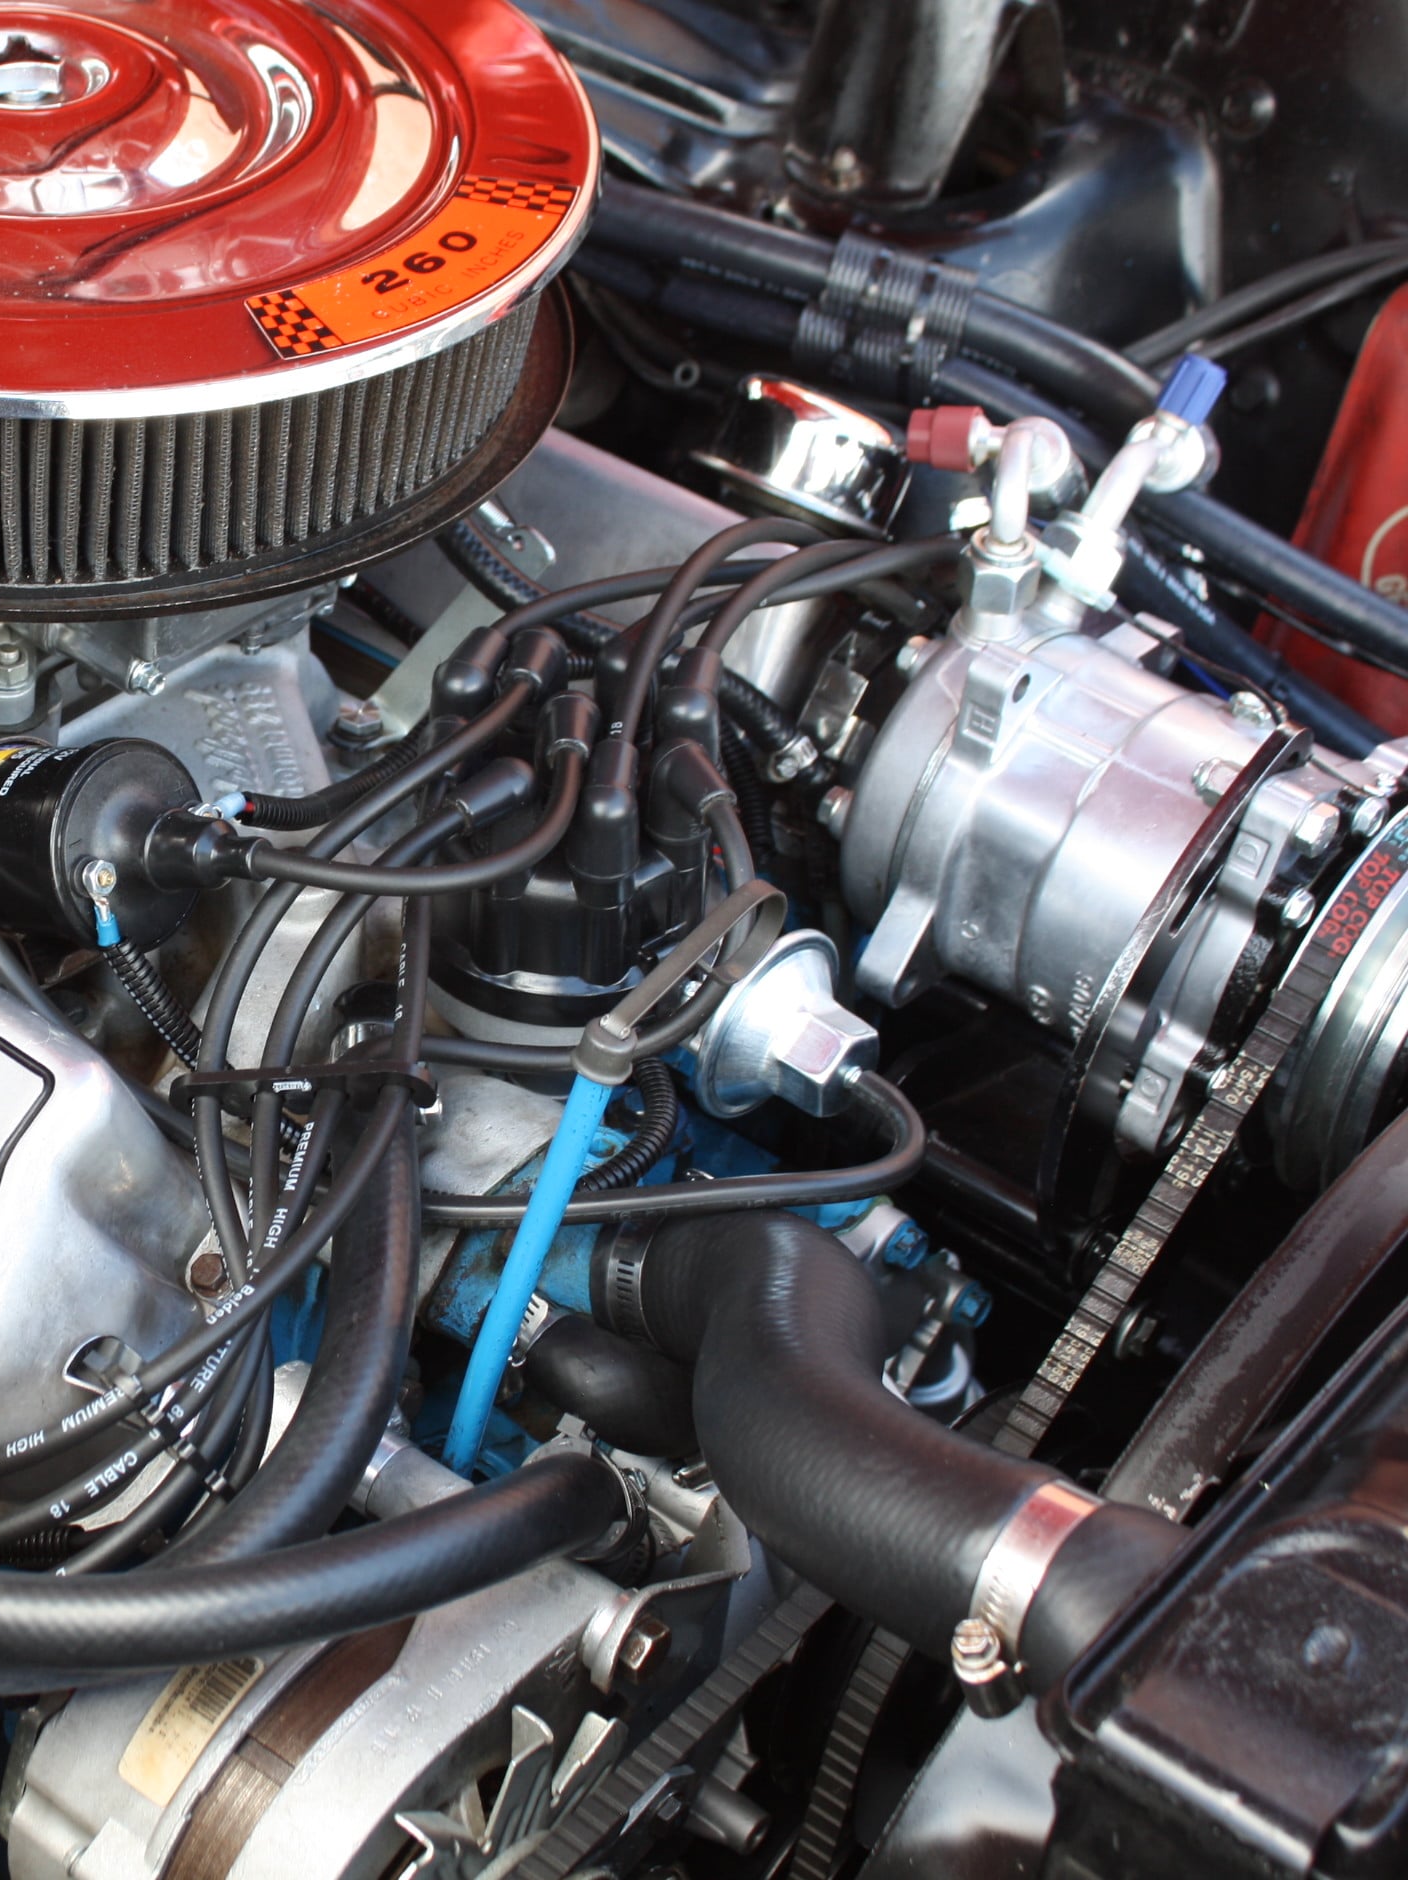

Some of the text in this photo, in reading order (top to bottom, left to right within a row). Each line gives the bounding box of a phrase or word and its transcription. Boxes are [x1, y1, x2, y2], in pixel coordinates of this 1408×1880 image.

[361, 231, 477, 294] 260
[372, 229, 524, 319] CUBIC INCHES
[610, 721, 623, 735] 18
[1356, 850, 1391, 889] TOP
[1365, 868, 1401, 910] TOP
[284, 1121, 316, 1191] PREMIUM
[263, 1207, 289, 1249] HIGH
[206, 1283, 256, 1326] Belden
[5, 1429, 45, 1458] HIGH
[84, 1451, 139, 1497] CABLE
[49, 1499, 72, 1519] 18
